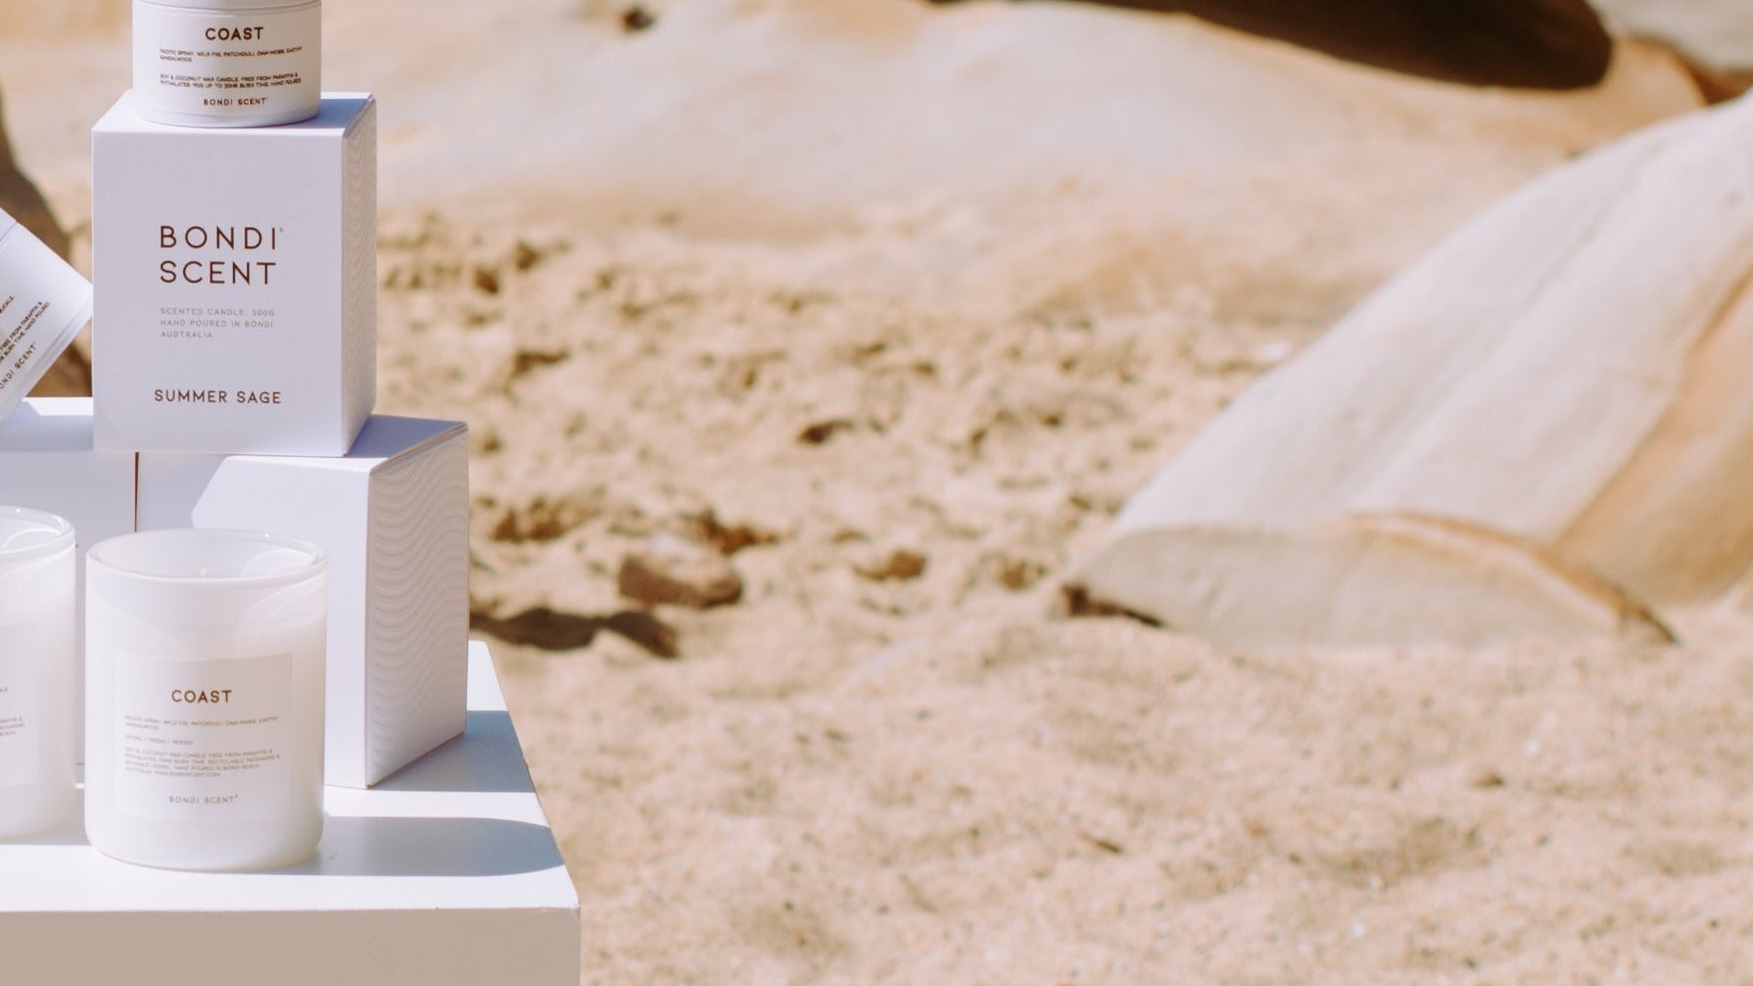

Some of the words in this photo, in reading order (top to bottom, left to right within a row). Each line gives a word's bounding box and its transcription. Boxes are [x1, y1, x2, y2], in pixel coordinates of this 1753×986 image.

[205, 26, 264, 41] COAST
[160, 260, 276, 285] SCENT
[160, 319, 186, 327] HAND
[189, 320, 227, 328] POURED
[231, 320, 241, 328] IN
[160, 331, 213, 339] AUSTRALIA
[154, 389, 228, 403] SUMMER
[236, 391, 281, 404] SAGE
[171, 689, 233, 704] COAST
